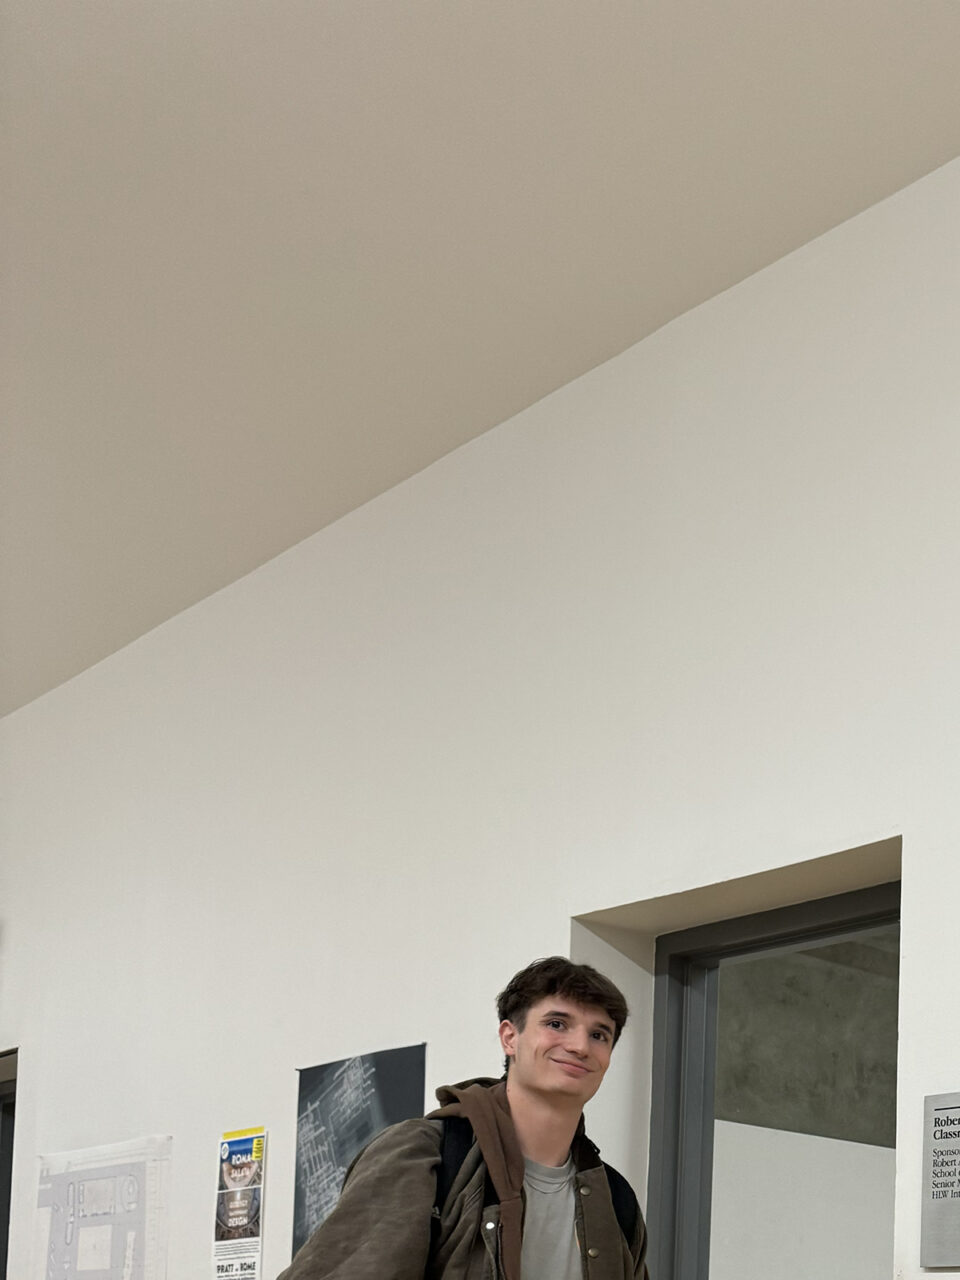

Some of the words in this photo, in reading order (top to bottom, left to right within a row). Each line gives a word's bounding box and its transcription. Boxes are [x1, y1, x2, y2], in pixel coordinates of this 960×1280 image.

[933, 1158, 956, 1168] Robert
[932, 1168, 956, 1178] School
[932, 1180, 956, 1189] Senior
